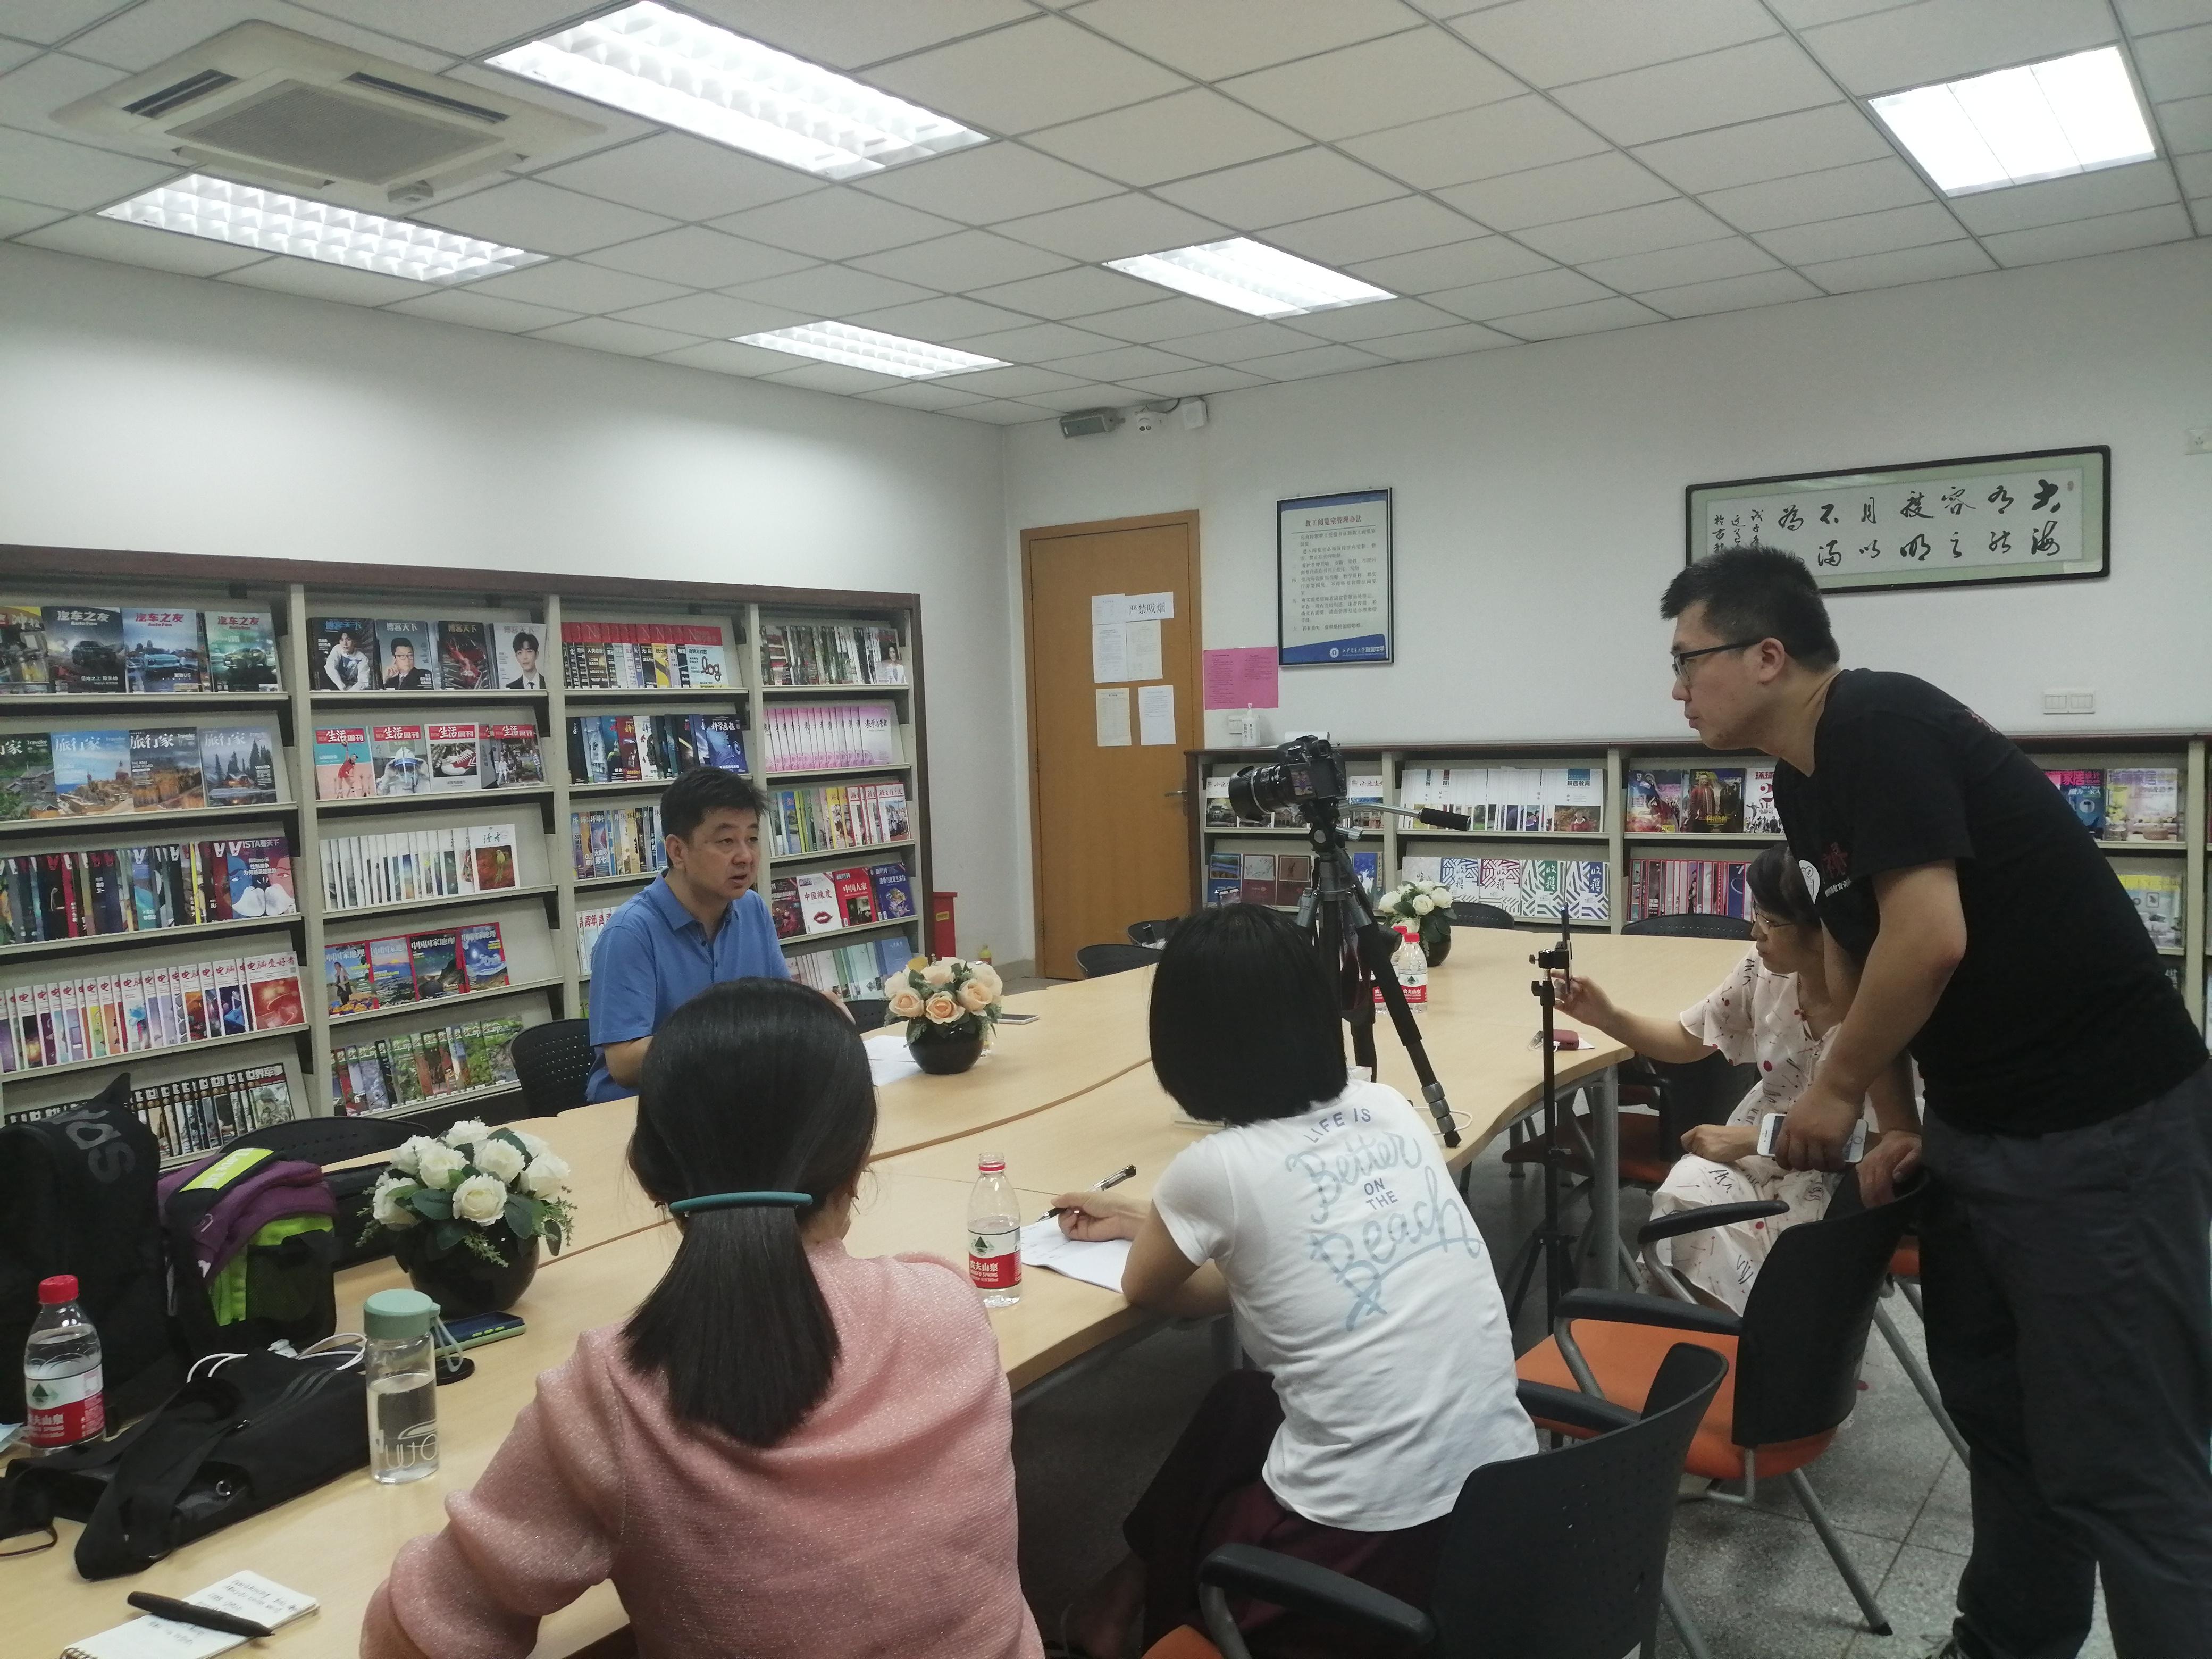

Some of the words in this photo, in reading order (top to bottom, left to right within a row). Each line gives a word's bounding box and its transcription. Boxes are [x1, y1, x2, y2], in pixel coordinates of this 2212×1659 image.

[1128, 602, 1166, 615] 严禁吸烟
[57, 610, 110, 622] 汽车之友
[136, 613, 184, 623] 汽车之友
[217, 616, 259, 626] 汽车之友
[387, 622, 418, 632] 博客天下
[56, 737, 101, 752] 旅行家
[130, 733, 174, 749] 旅行家
[205, 732, 246, 747] 旅行家
[483, 832, 501, 844] 读者
[843, 882, 868, 893] 中国人家
[585, 915, 597, 928] 青年
[411, 936, 455, 950] 中国国家地理
[247, 956, 296, 971] 电脑爱好者
[245, 1065, 283, 1082] 世界军事
[1304, 1112, 1345, 1144] LIFE
[1354, 1107, 1371, 1123] IS
[1285, 1131, 1422, 1225] Better
[1364, 1177, 1386, 1196] ON
[1365, 1191, 1398, 1211] THE
[969, 1260, 999, 1273] 农夫山泉
